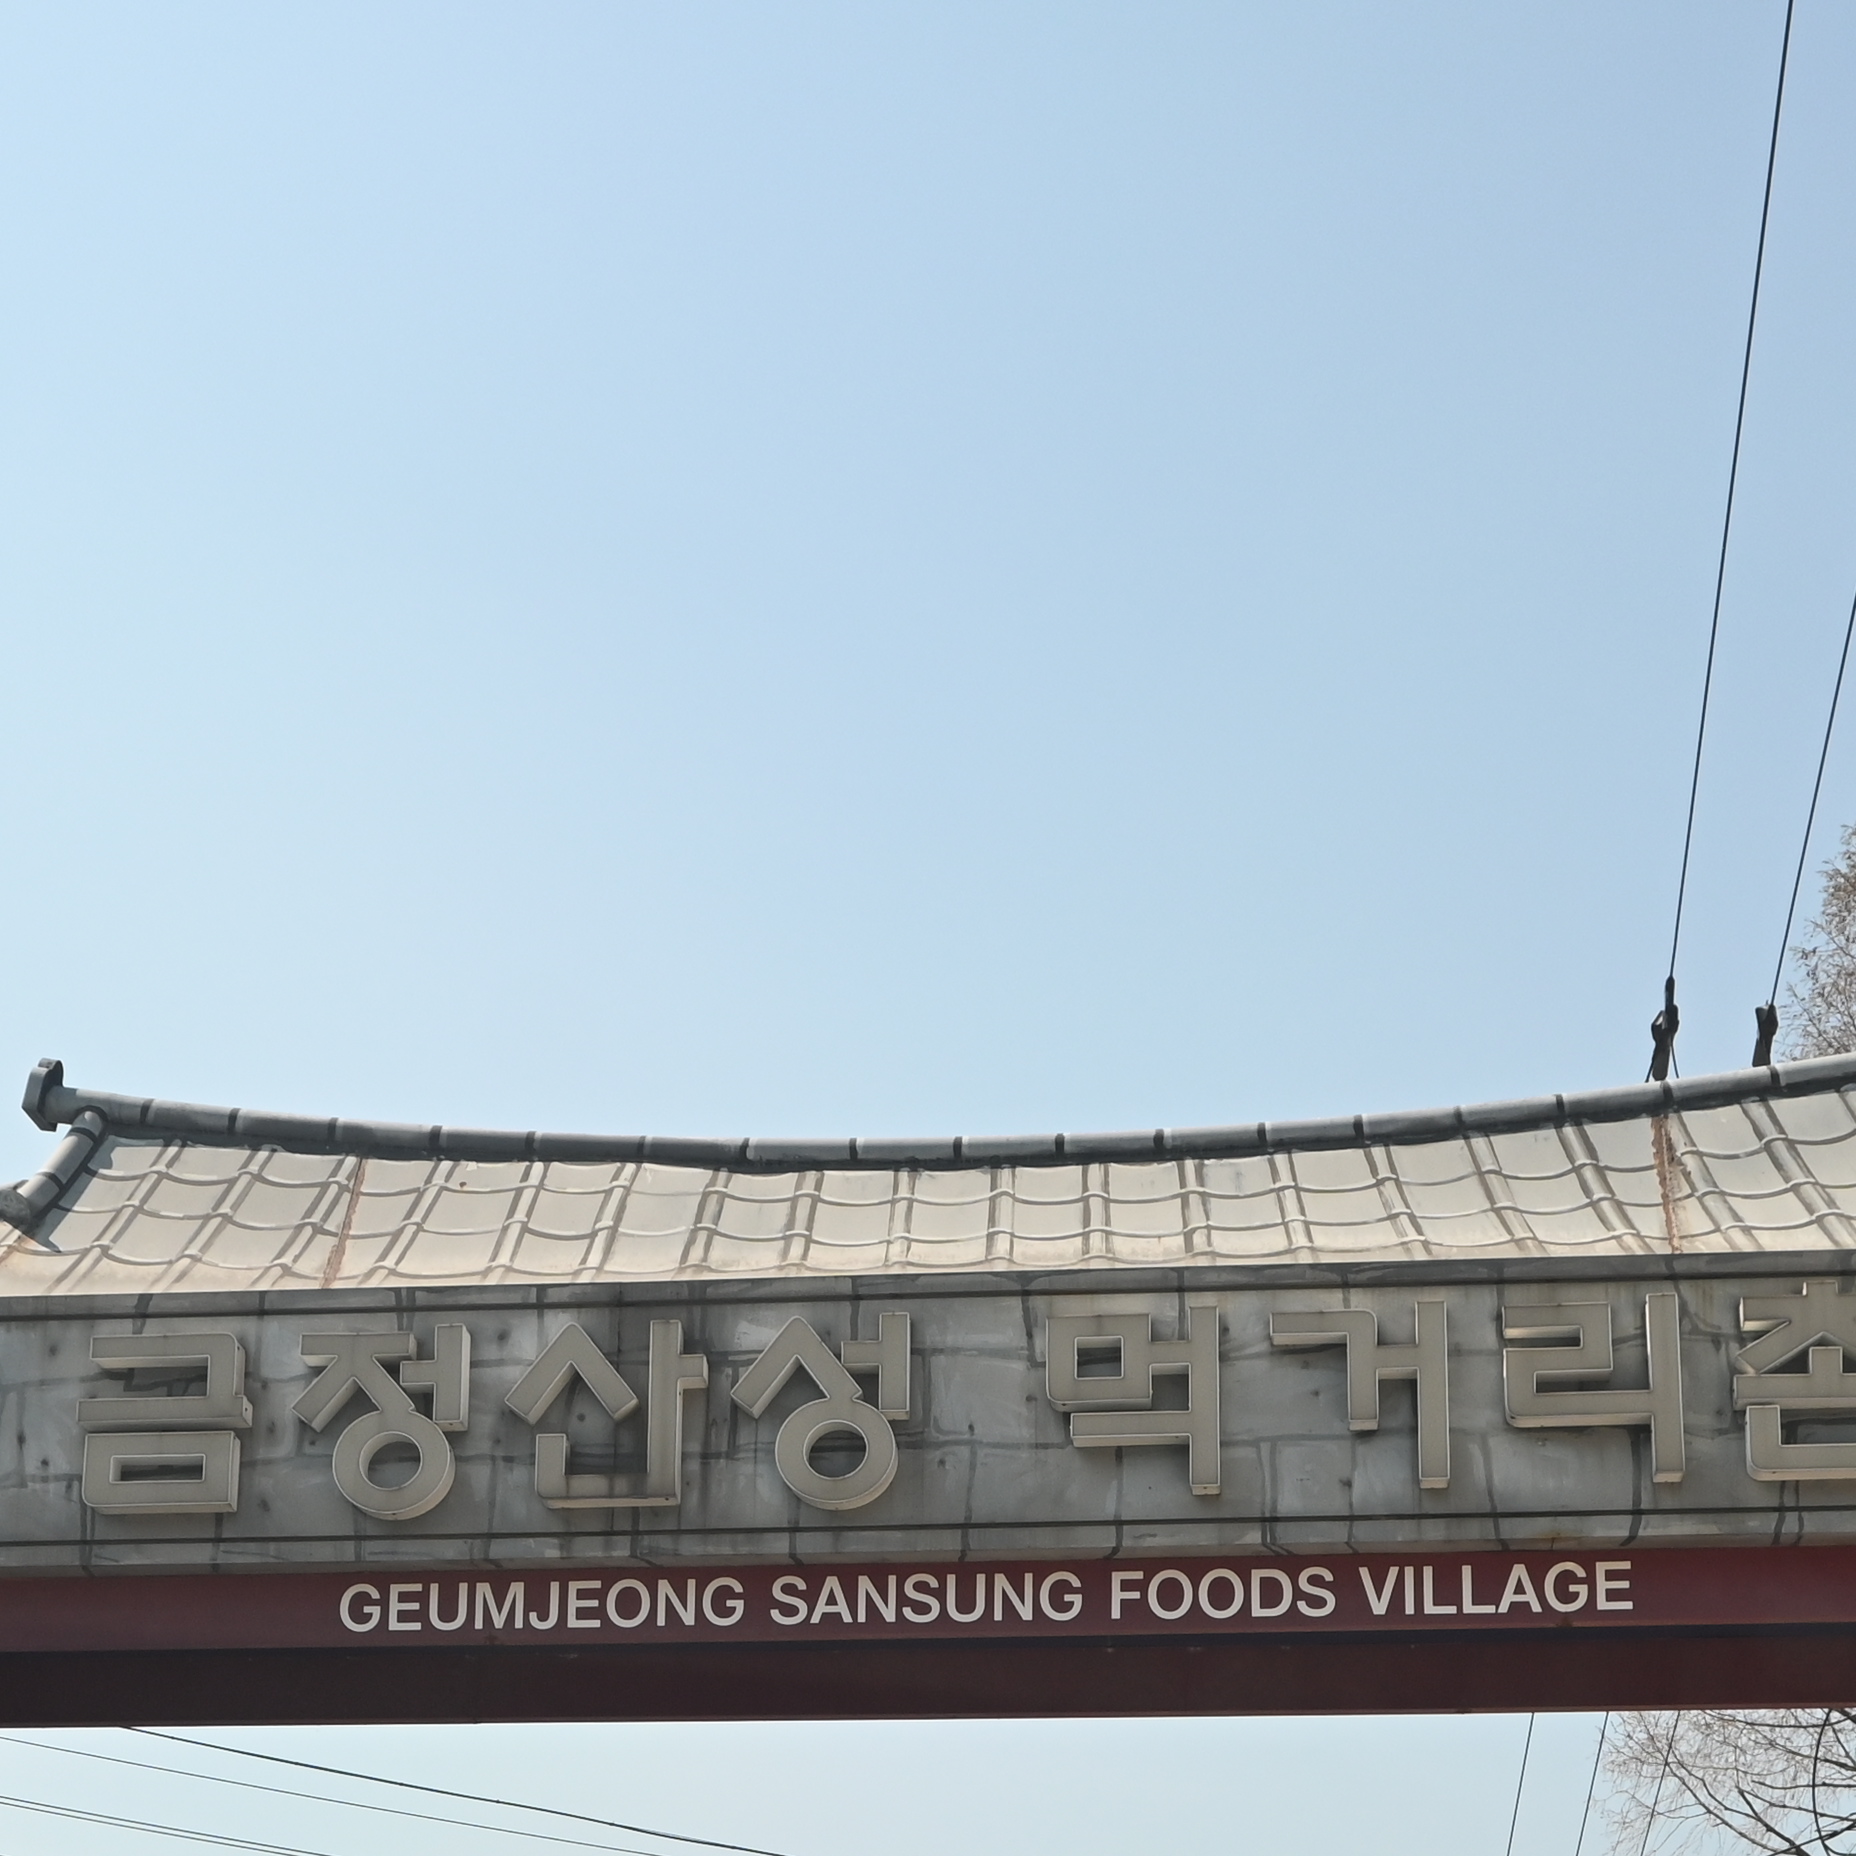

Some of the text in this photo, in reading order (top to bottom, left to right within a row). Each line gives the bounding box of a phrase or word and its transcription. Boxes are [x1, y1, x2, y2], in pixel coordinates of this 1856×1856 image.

[76, 1310, 912, 1522] 금정산성
[338, 1559, 1634, 1633] GEUMJEONG SANSUNG FOODS VILLAGE
